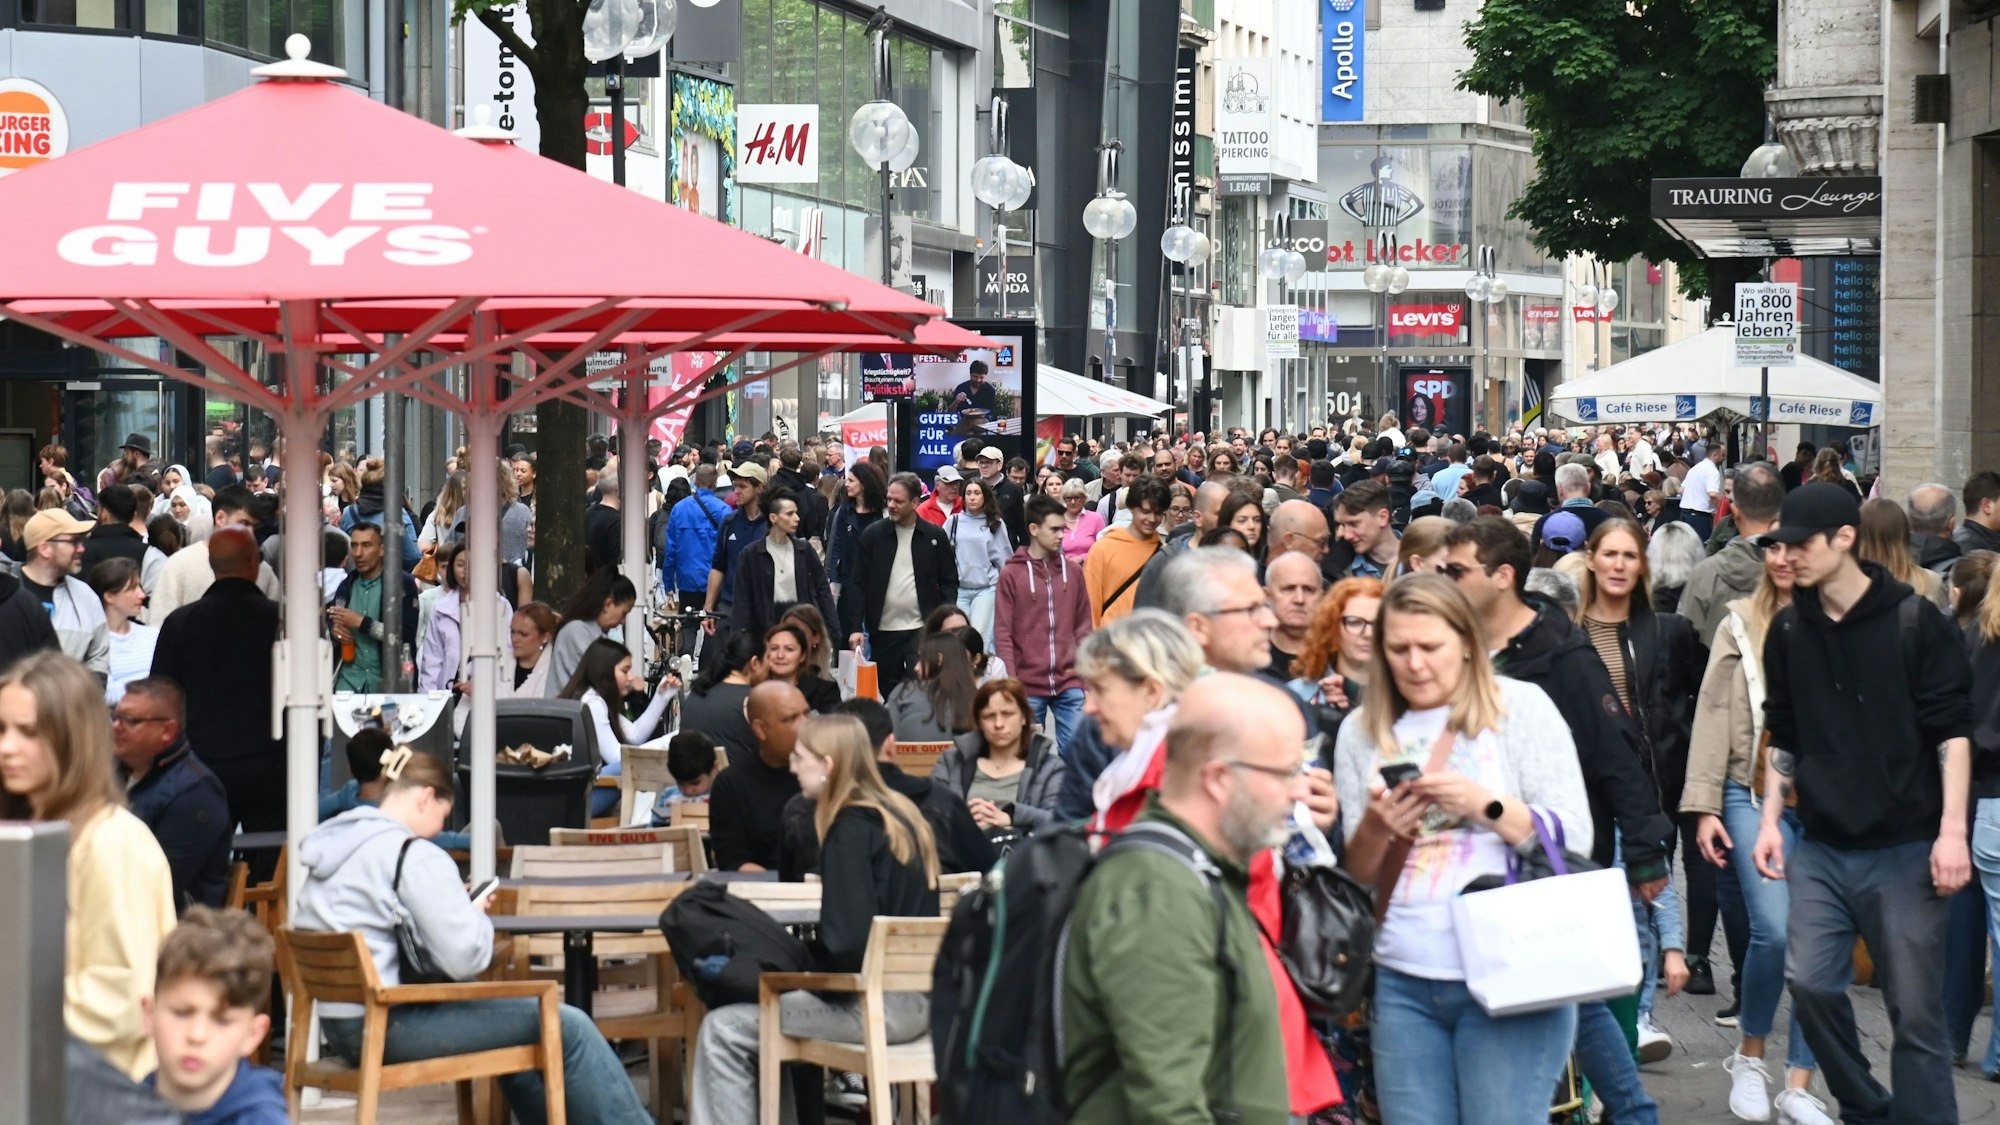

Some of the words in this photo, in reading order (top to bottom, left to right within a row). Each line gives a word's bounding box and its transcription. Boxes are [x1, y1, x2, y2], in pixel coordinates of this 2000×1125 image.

[1332, 21, 1359, 100] Apollo
[0, 115, 51, 132] URGER
[745, 121, 810, 166] H&M
[1222, 131, 1269, 145] TATTOO
[1221, 147, 1269, 158] PIERCING
[1229, 182, 1261, 193] 1.ETAGE
[106, 182, 433, 221] FIVE
[1669, 188, 1773, 206] TRAURING
[1780, 180, 1880, 212] Lounge
[56, 225, 474, 267] GUYS
[1328, 240, 1355, 262] ot
[1835, 262, 1864, 272] hello
[987, 272, 1028, 284] VRO
[1835, 275, 1863, 286] hello
[1835, 289, 1863, 300] hello
[1740, 294, 1755, 308] in
[1761, 294, 1792, 309] 800
[1834, 303, 1863, 313] hello
[1269, 313, 1296, 323] langes
[1737, 308, 1794, 322] Jahren
[1270, 322, 1296, 331] Leben
[1737, 322, 1793, 337] leben?
[1267, 331, 1281, 340] für
[1283, 331, 1298, 340] alle
[1834, 331, 1862, 341] hello
[1834, 345, 1862, 355] hello
[1413, 380, 1457, 400] SPD
[1326, 391, 1362, 416] 501
[1605, 402, 1632, 414] Café
[1635, 402, 1667, 413] Riese
[1778, 402, 1806, 414] Café
[1809, 404, 1842, 417] Riese
[919, 413, 959, 425] GUTES
[919, 427, 944, 441] FÜR
[918, 444, 952, 455] ALLE.
[587, 833, 615, 843] FIVE
[620, 831, 657, 843] GUYS
